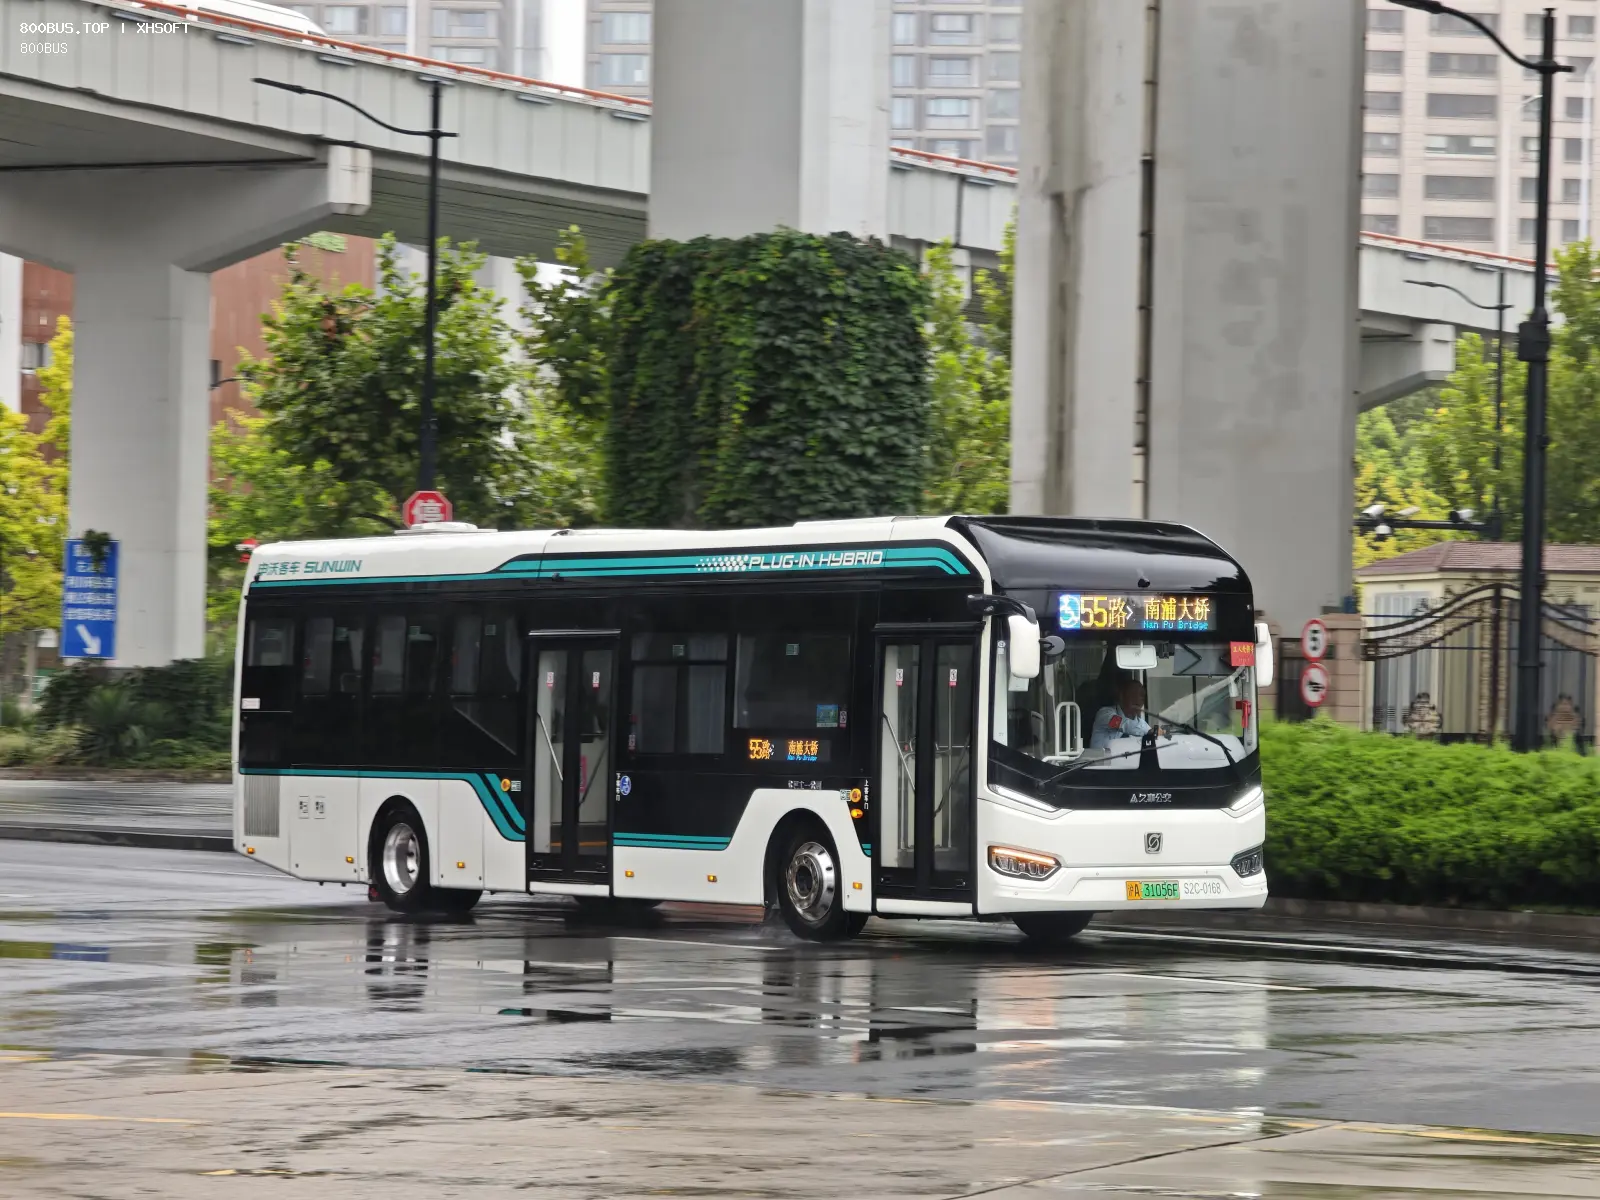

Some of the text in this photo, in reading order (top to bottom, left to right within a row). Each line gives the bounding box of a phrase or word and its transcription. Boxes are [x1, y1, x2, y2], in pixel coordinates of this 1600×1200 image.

[303, 560, 362, 573] SUNWIN
[748, 551, 883, 569] PLUG-IN HYBRID
[1080, 597, 1211, 628] 55路 南浦大桥
[1143, 620, 1209, 630] Nan Pu Bridge
[1184, 882, 1221, 895] S2C-0168
